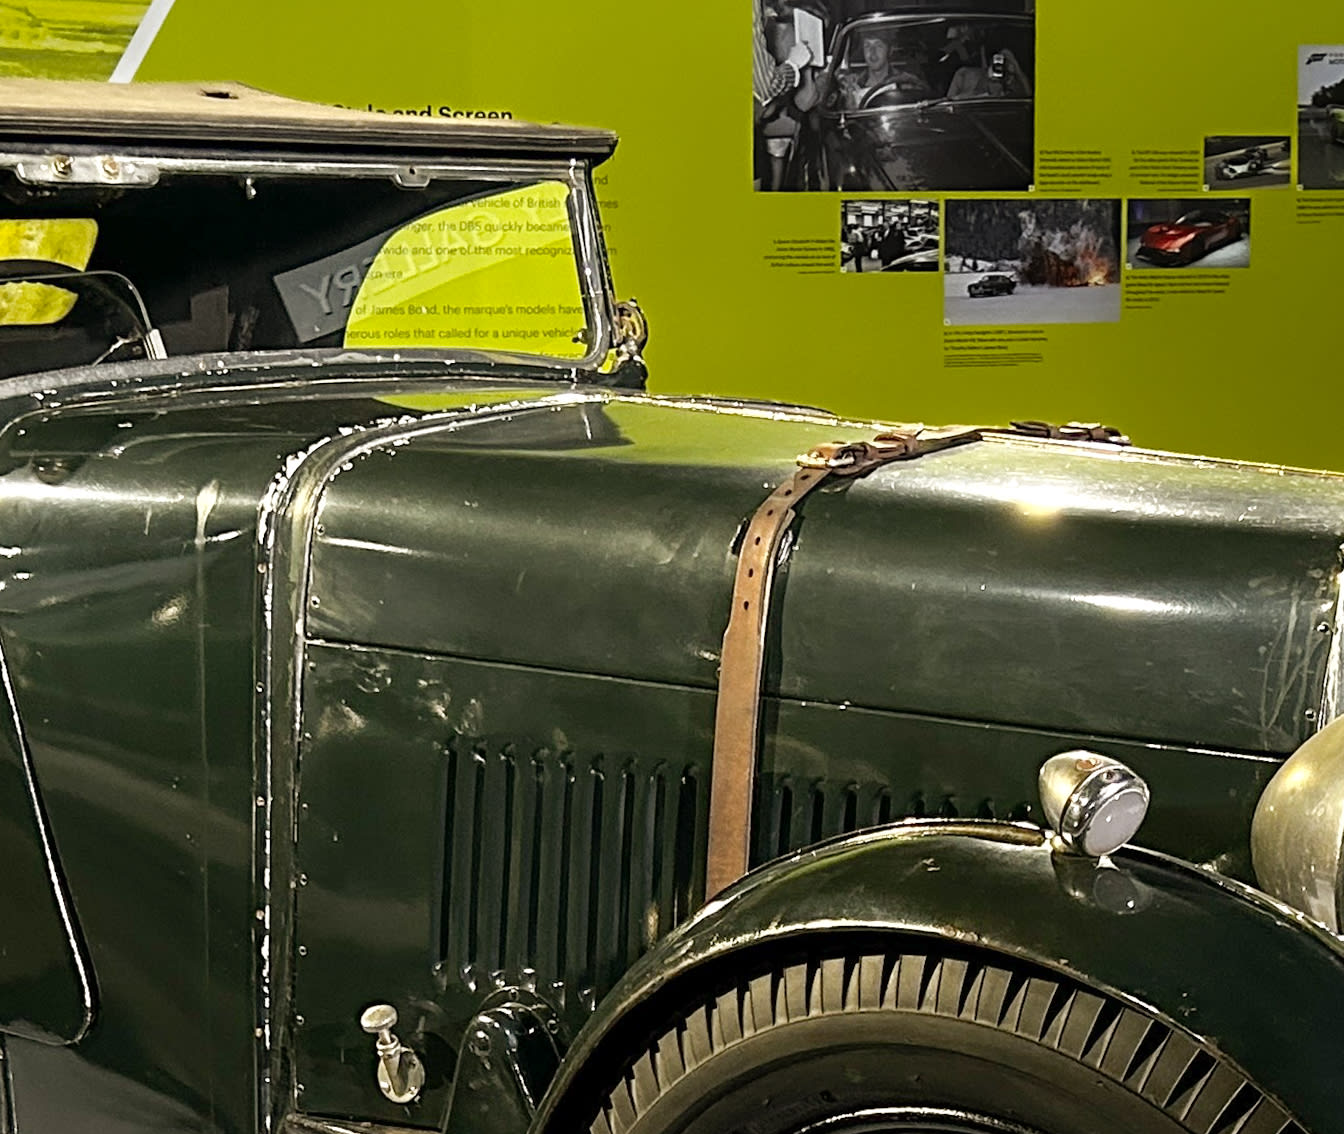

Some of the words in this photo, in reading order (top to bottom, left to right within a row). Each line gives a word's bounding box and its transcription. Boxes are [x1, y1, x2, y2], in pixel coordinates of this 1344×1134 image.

[513, 198, 524, 208] of
[438, 221, 455, 232] the
[484, 221, 522, 235] quickly
[411, 246, 433, 256] and
[435, 247, 457, 256] one
[356, 305, 367, 315] of
[443, 305, 461, 315] the
[516, 305, 556, 315] models
[384, 328, 409, 339] roles
[413, 328, 436, 339] that
[439, 328, 472, 339] called
[475, 328, 490, 339] for
[502, 329, 540, 341] unique
[542, 328, 579, 339] vehicl
